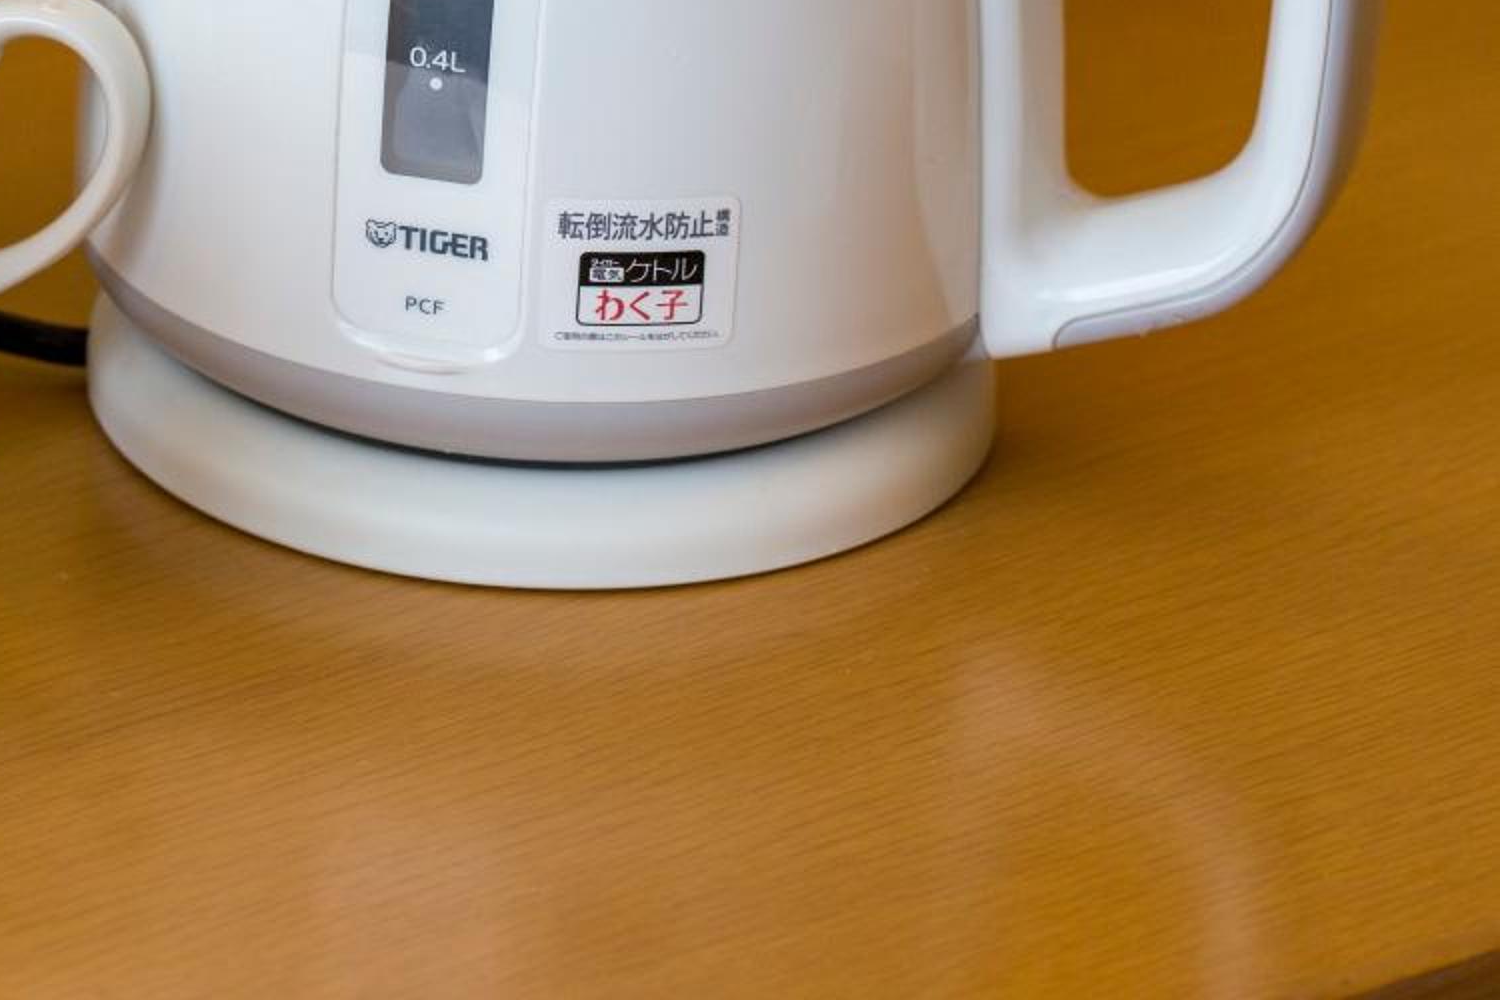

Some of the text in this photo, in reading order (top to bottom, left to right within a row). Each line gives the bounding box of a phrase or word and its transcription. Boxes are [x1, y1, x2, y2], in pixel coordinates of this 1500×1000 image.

[409, 46, 467, 73] 0.4L
[399, 225, 489, 262] TIGER
[404, 295, 446, 316] PCF
[595, 289, 689, 321] わく子
